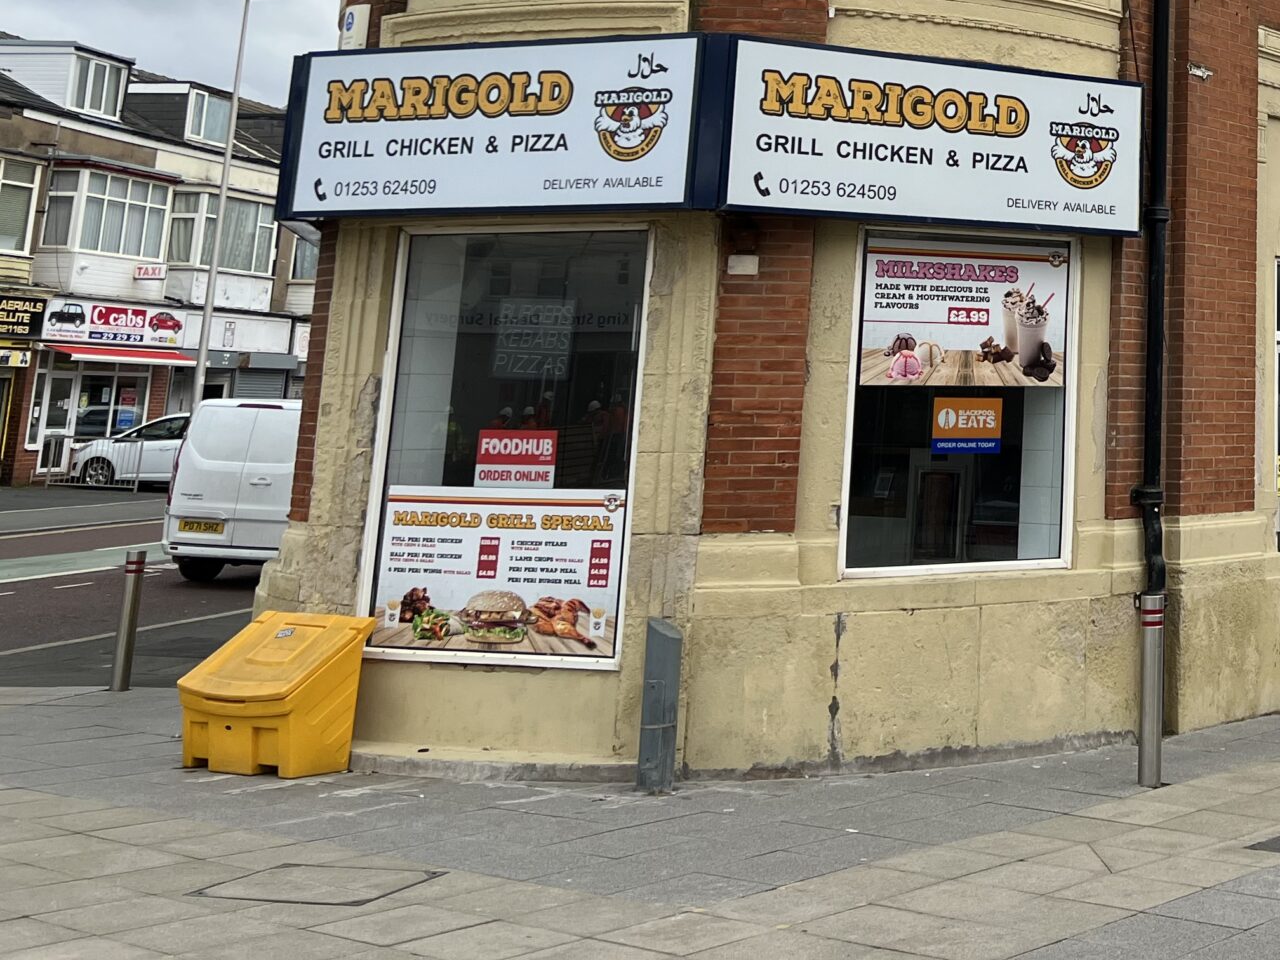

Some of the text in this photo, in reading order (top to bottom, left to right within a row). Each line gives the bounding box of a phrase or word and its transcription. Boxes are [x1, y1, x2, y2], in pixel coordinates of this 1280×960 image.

[627, 52, 669, 79] حلال
[324, 70, 574, 123] MARIGOLD
[596, 91, 671, 104] MARIGOLD
[760, 68, 1029, 138] MARIGOLD
[1078, 92, 1115, 117] حلال
[1051, 124, 1118, 140] MARIGOLD
[318, 133, 568, 159] GRILL CHICKEN & PIZZA
[755, 133, 1028, 173] GRILL CHICKEN & PIZZA
[334, 179, 437, 198] 01253 624509
[543, 176, 664, 191] DELIVERY AVAILABLE
[779, 178, 897, 201] 01253 624509
[1007, 198, 1116, 215] DELIVERY AVAILABLE
[137, 267, 161, 277] TAXI
[875, 260, 1019, 283] MILKSHAKES
[904, 284, 927, 292] WITH
[930, 285, 973, 293] DELICIOUS
[0, 300, 43, 312] AERIALS
[874, 302, 919, 310] FLAVOURS
[916, 294, 990, 303] MOUTHWATERING
[0, 311, 31, 323] ELLITE
[93, 306, 144, 327] C cabs
[501, 304, 574, 323] BURGERS
[949, 310, 988, 322] £2.99
[0, 325, 29, 334] 21163
[102, 332, 114, 340] 29
[116, 333, 127, 341] 29
[497, 329, 571, 349] KEBABS
[495, 353, 568, 375] PIZZAS
[958, 416, 995, 429] EATS
[481, 438, 553, 455] FOODHUB
[479, 470, 550, 482] ORDER ONLINE
[393, 511, 613, 532] MARIGOLD GRILL SPECIAL
